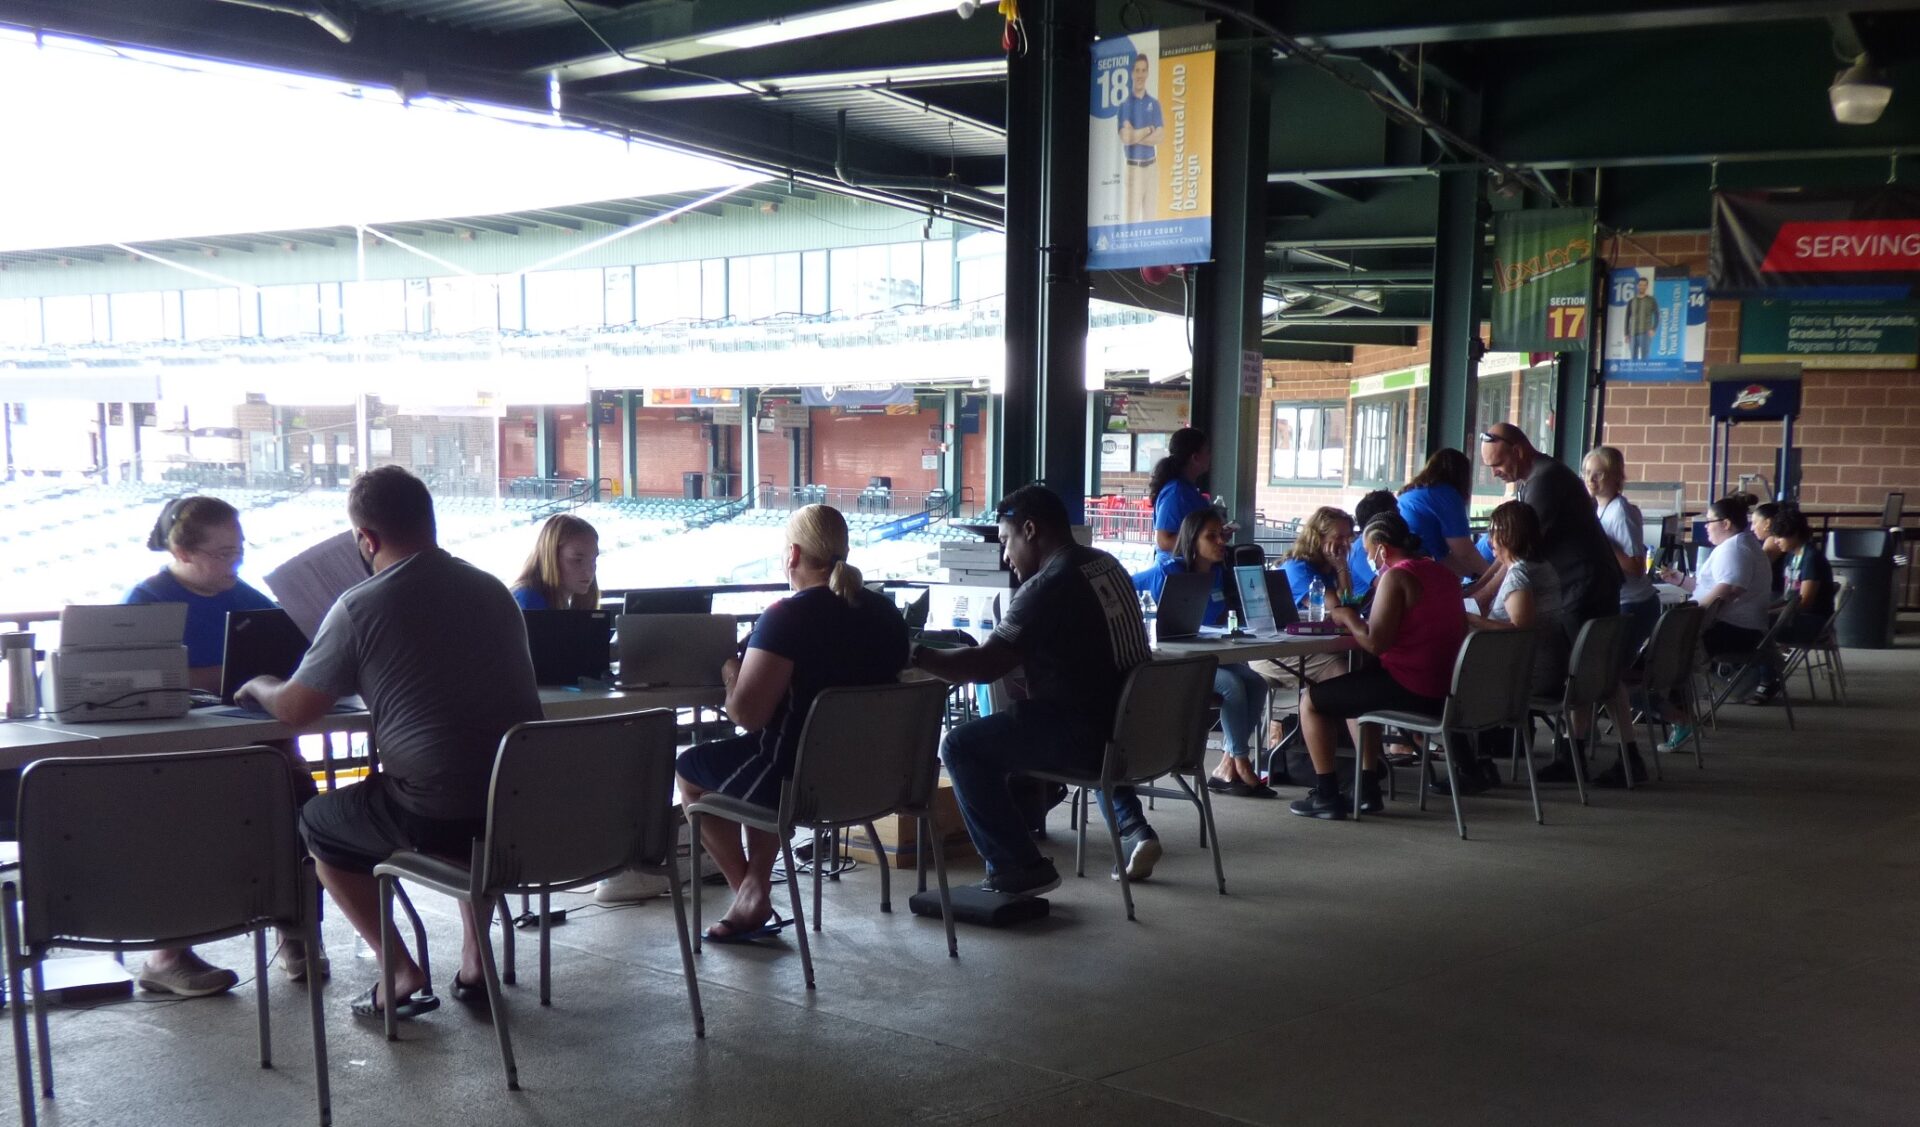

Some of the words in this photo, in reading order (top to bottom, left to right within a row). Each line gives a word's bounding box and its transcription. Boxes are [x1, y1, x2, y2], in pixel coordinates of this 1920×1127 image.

[1097, 55, 1130, 71] SECTION
[1096, 67, 1130, 109] 18
[1169, 64, 1186, 211] Architectural/CAD
[1183, 154, 1201, 211] Design
[1154, 226, 1183, 235] COUNTY
[1795, 233, 1920, 258] SERVING
[1550, 297, 1586, 306] SECTION
[1613, 282, 1635, 302] 16
[1549, 307, 1585, 338] 17
[1658, 307, 1669, 356] Commercial
[1789, 315, 1832, 328] Offering
[1788, 328, 1837, 339] Graduate
[1847, 328, 1883, 339] Online
[1668, 334, 1678, 356] Truck
[1787, 340, 1835, 354] Programs
[1836, 340, 1847, 352] of
[1848, 340, 1879, 354] Study
